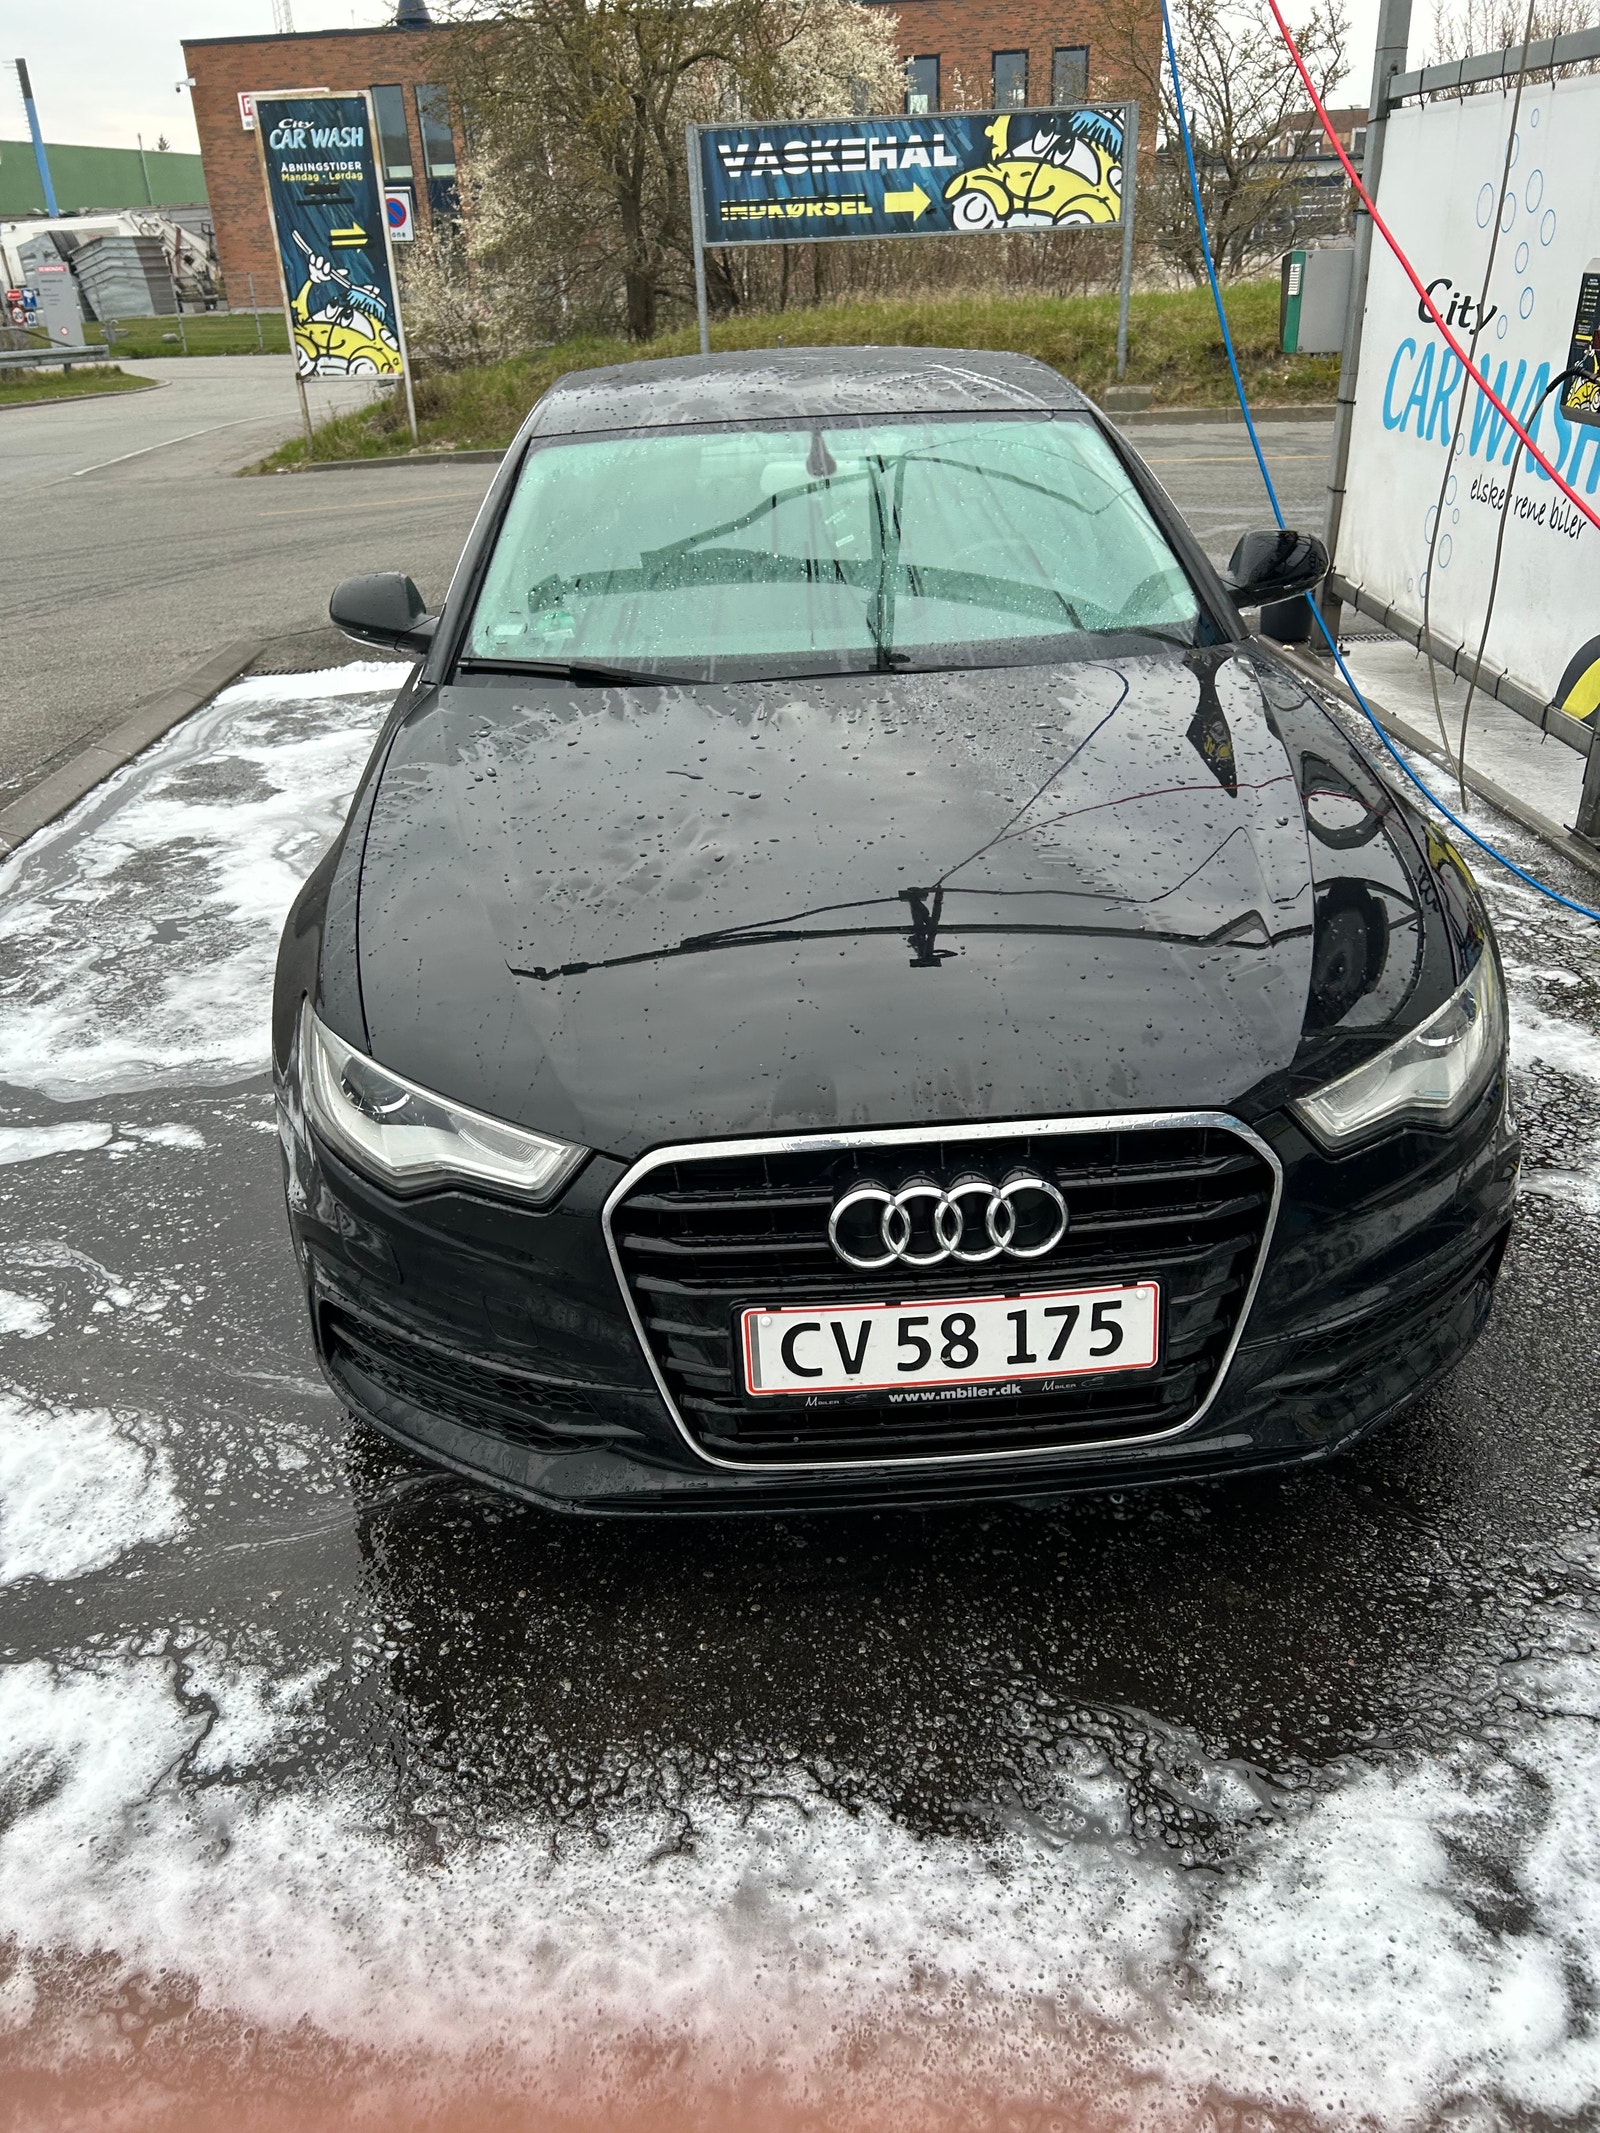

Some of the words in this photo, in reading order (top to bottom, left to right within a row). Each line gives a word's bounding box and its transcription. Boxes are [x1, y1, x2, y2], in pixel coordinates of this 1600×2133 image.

[269, 128, 307, 150] CAR
[310, 126, 364, 149] WASH
[278, 118, 315, 129] City
[281, 161, 362, 173] ÅBNINGSTIDER
[718, 133, 957, 178] VASKEHAL
[281, 173, 320, 182] Mandag
[328, 171, 364, 181] Lørdag
[1417, 278, 1497, 335] City
[1382, 337, 1463, 447] CAR
[1470, 474, 1513, 511] elske
[1513, 495, 1547, 526] rene
[1549, 496, 1587, 540] biler
[781, 1319, 872, 1377] CV
[897, 1312, 979, 1372] 58
[1006, 1299, 1124, 1364] 175
[888, 1383, 1022, 1403] www.mbiler.dk
